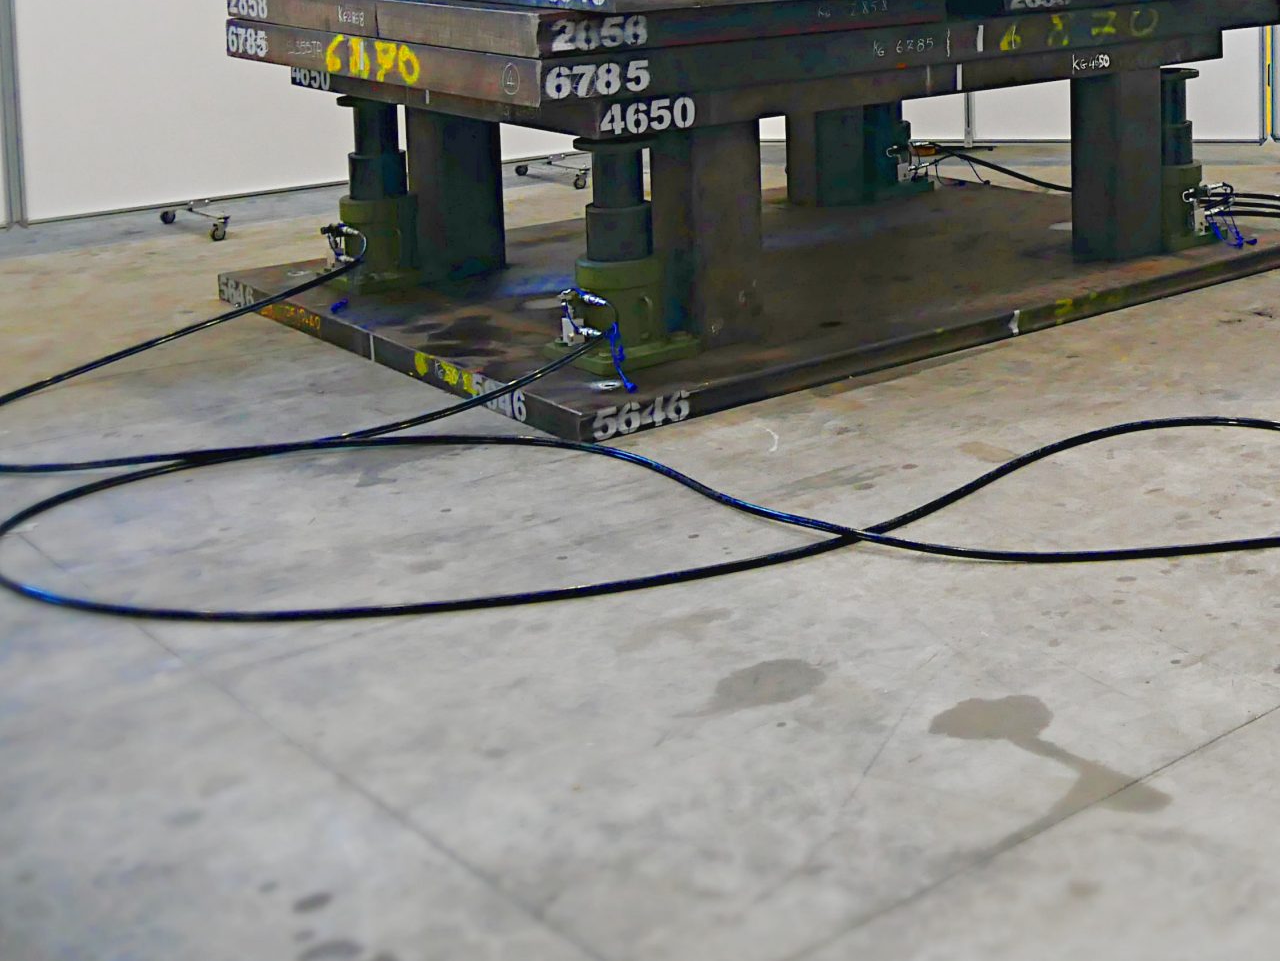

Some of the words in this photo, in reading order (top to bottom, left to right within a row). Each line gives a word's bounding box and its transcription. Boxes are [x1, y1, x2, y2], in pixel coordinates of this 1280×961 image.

[228, 26, 268, 57] 6785
[551, 15, 648, 51] 2858
[545, 60, 651, 100] 6785
[600, 97, 696, 135] 4650
[593, 390, 690, 439] 5646
